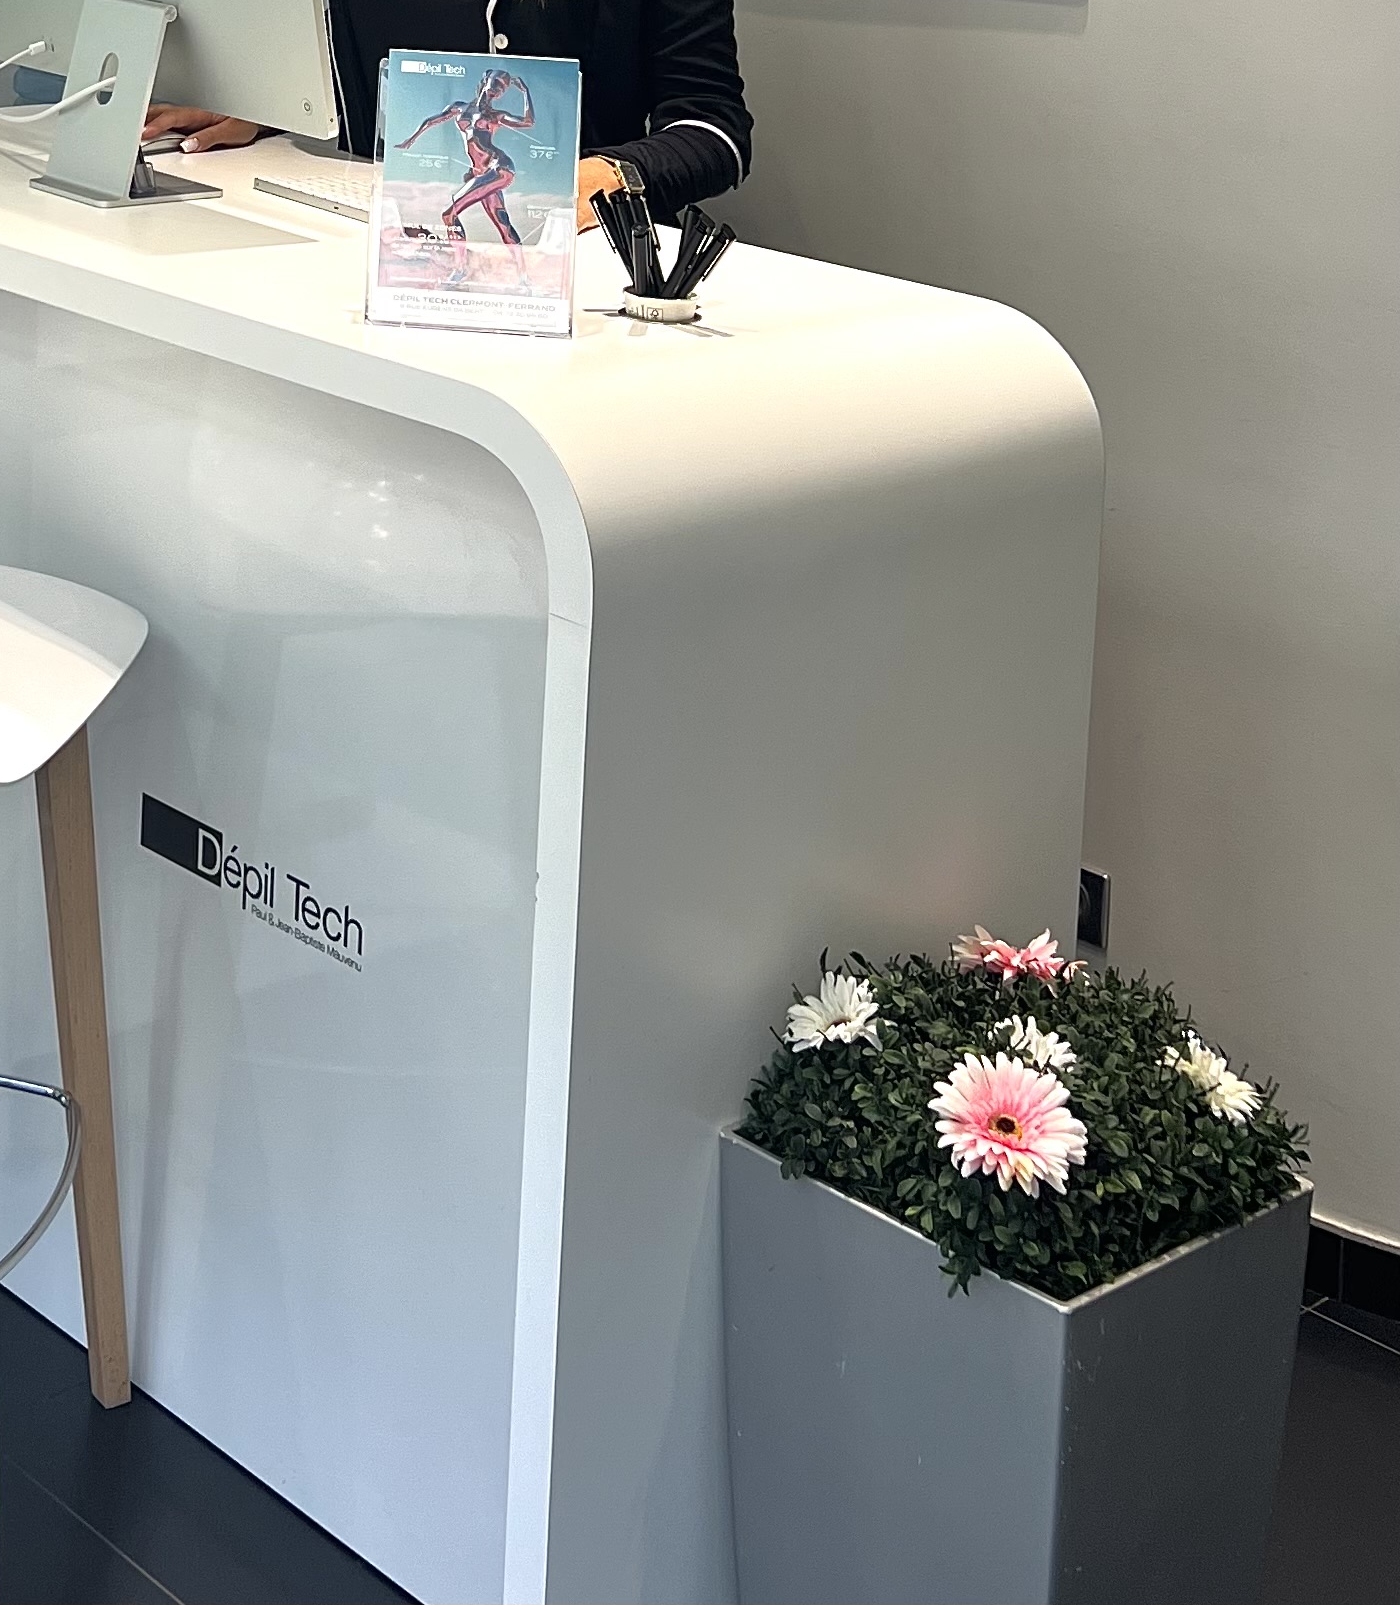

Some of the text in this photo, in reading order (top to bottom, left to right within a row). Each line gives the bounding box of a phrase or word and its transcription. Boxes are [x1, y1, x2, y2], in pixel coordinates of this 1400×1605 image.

[418, 62, 466, 76] Dépil Tech
[393, 293, 421, 303] DÉPIL
[423, 296, 448, 305] TECH
[197, 827, 363, 956] Dépil Tech
[251, 903, 362, 973] Paul & Jean-Baptiste Mauvenu
